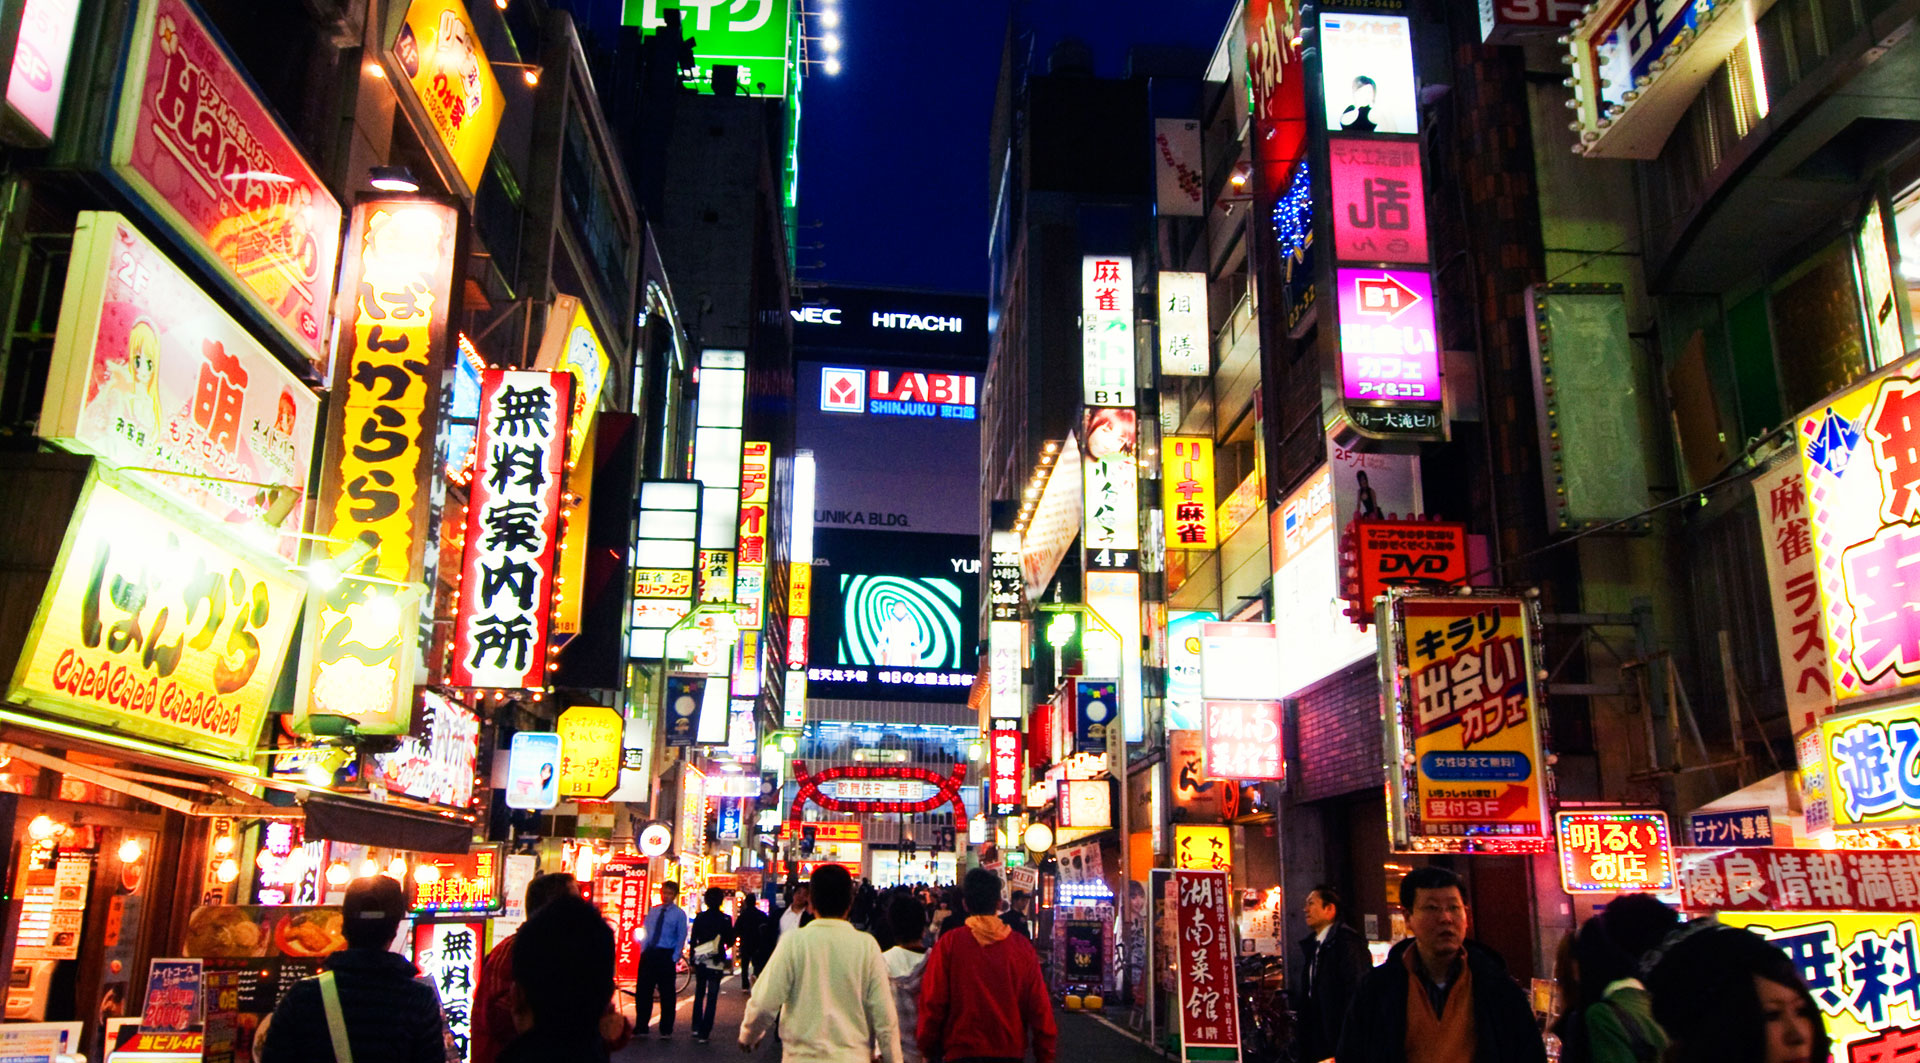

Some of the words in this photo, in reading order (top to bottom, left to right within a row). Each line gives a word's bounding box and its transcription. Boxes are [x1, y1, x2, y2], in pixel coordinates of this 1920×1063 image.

[1094, 260, 1122, 311] 麻雀
[1364, 286, 1400, 308] B1
[790, 307, 842, 324] NEC
[872, 312, 963, 333] HITACHI
[1358, 357, 1422, 379] カフェ
[869, 370, 975, 405] LABI
[1095, 391, 1122, 404] B1
[870, 400, 936, 417] SHINJUKU
[1335, 448, 1352, 461] 2F
[1175, 442, 1207, 544] リーチ麻雀
[470, 385, 551, 671] 無料案内所
[1769, 473, 1813, 565] 麻雀
[710, 552, 729, 577] 麻雀
[1094, 550, 1129, 567] 4F
[1379, 554, 1449, 577] DVD
[637, 584, 690, 595] スリーファイブ
[638, 573, 664, 583] 麻雀
[672, 573, 688, 584] 2F
[996, 607, 1017, 618] 3F
[1415, 607, 1500, 661] キラリ
[1418, 640, 1517, 726] 出会い
[1462, 692, 1525, 744] カフェ
[1435, 757, 1516, 769] 女性は全て無料!
[572, 782, 592, 793] B1
[837, 782, 923, 797] 歌舞伎町一番街
[997, 803, 1014, 815] 2F
[1430, 801, 1499, 817] 受付3F
[1570, 823, 1658, 854] 明るい
[1694, 815, 1772, 844] テナント募集
[1590, 851, 1649, 883] お店
[619, 879, 639, 964] 一品無料サービス
[1181, 876, 1221, 1022] 湖南菜館
[137, 1034, 203, 1051] 当ビル4F
